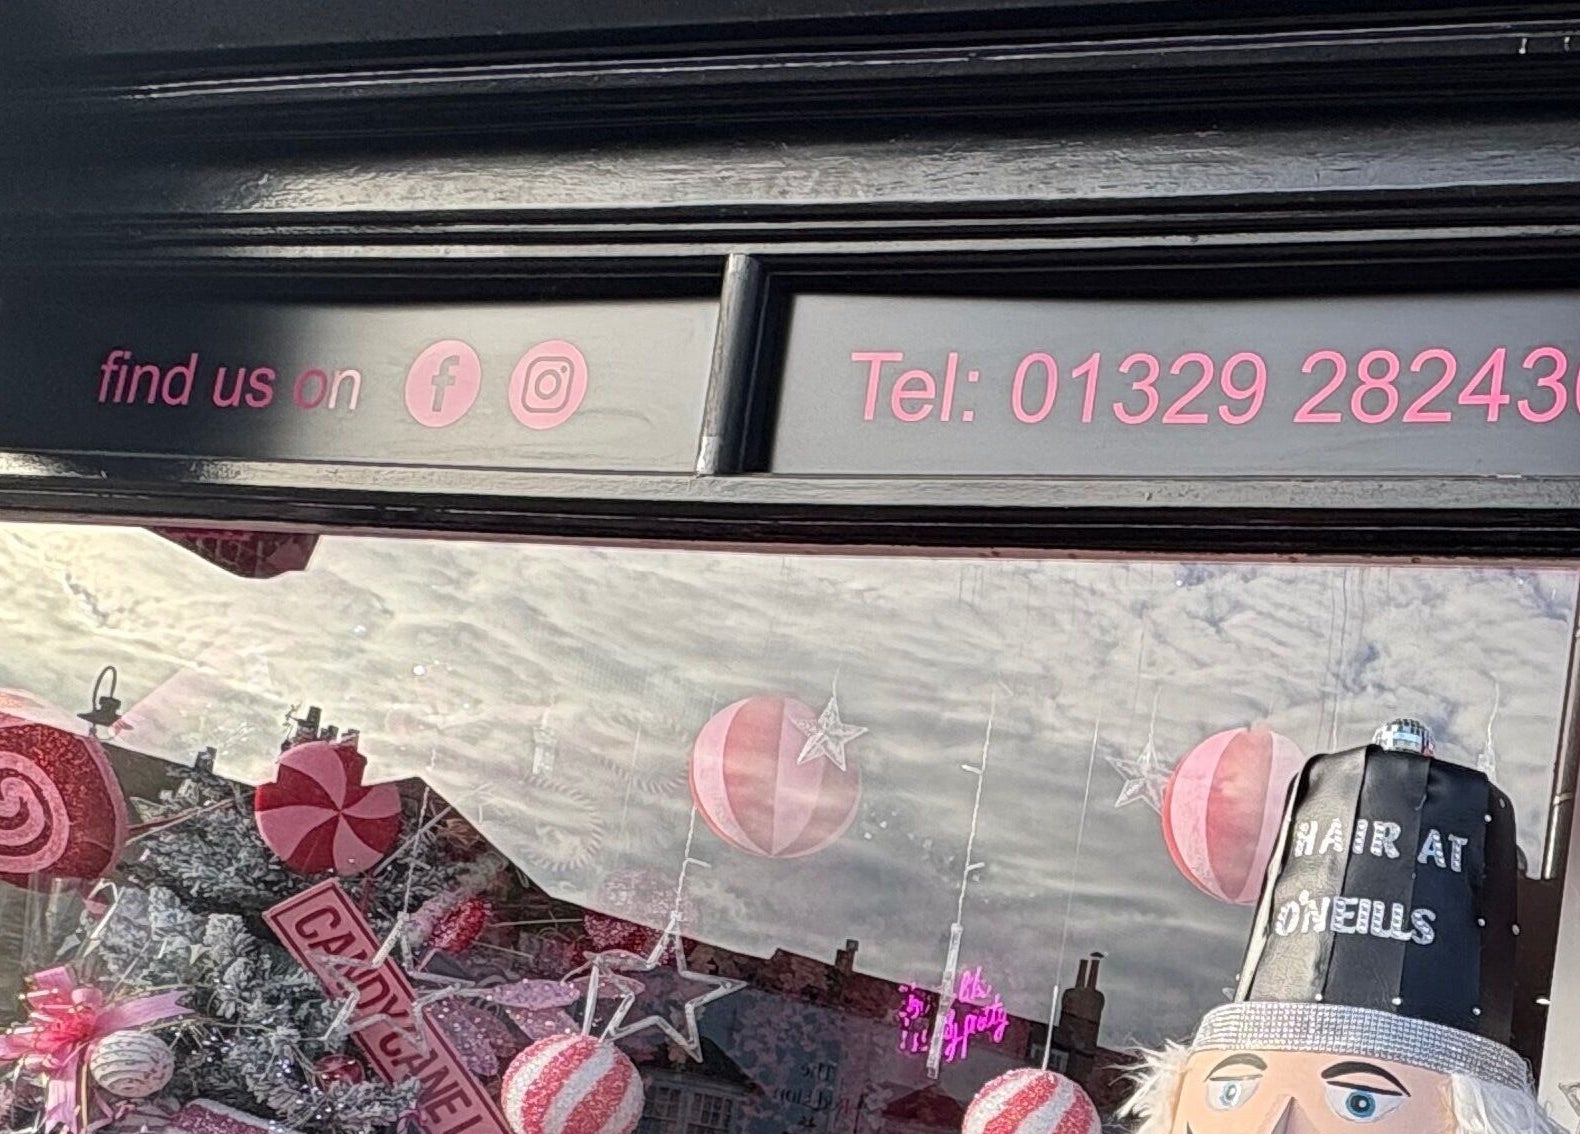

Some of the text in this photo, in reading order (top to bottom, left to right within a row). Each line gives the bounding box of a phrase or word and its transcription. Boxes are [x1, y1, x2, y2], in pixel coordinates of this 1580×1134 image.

[97, 349, 199, 406] find
[211, 366, 277, 409] us
[293, 367, 362, 411] on
[850, 351, 980, 422] Tel:
[1010, 351, 1268, 426] 01329
[1293, 817, 1469, 873] HAIR AT
[1275, 889, 1437, 946] O'NEILLS
